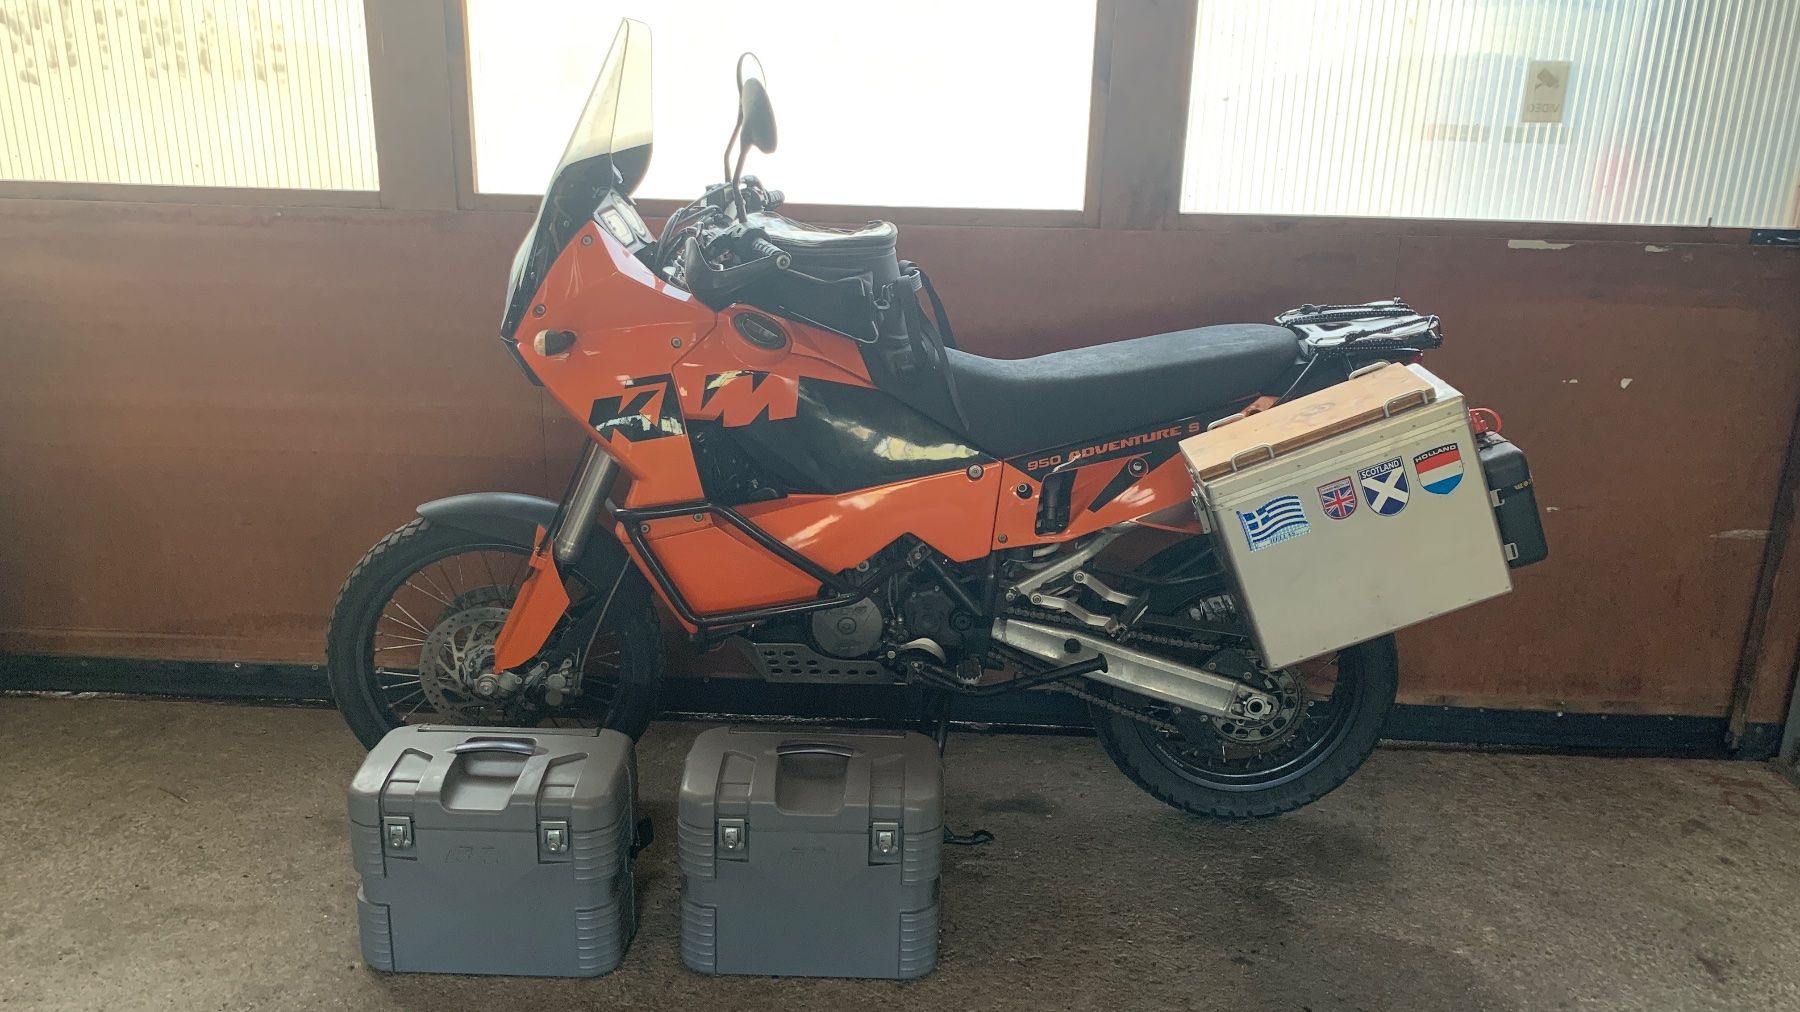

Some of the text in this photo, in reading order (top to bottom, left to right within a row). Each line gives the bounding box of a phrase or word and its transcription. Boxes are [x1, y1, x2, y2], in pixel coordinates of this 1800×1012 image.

[588, 370, 800, 445] KTM
[1027, 421, 1200, 471] 950 ADVENTURE S
[1414, 443, 1458, 463] HOLLAND
[1361, 459, 1400, 479] SCOTLAND
